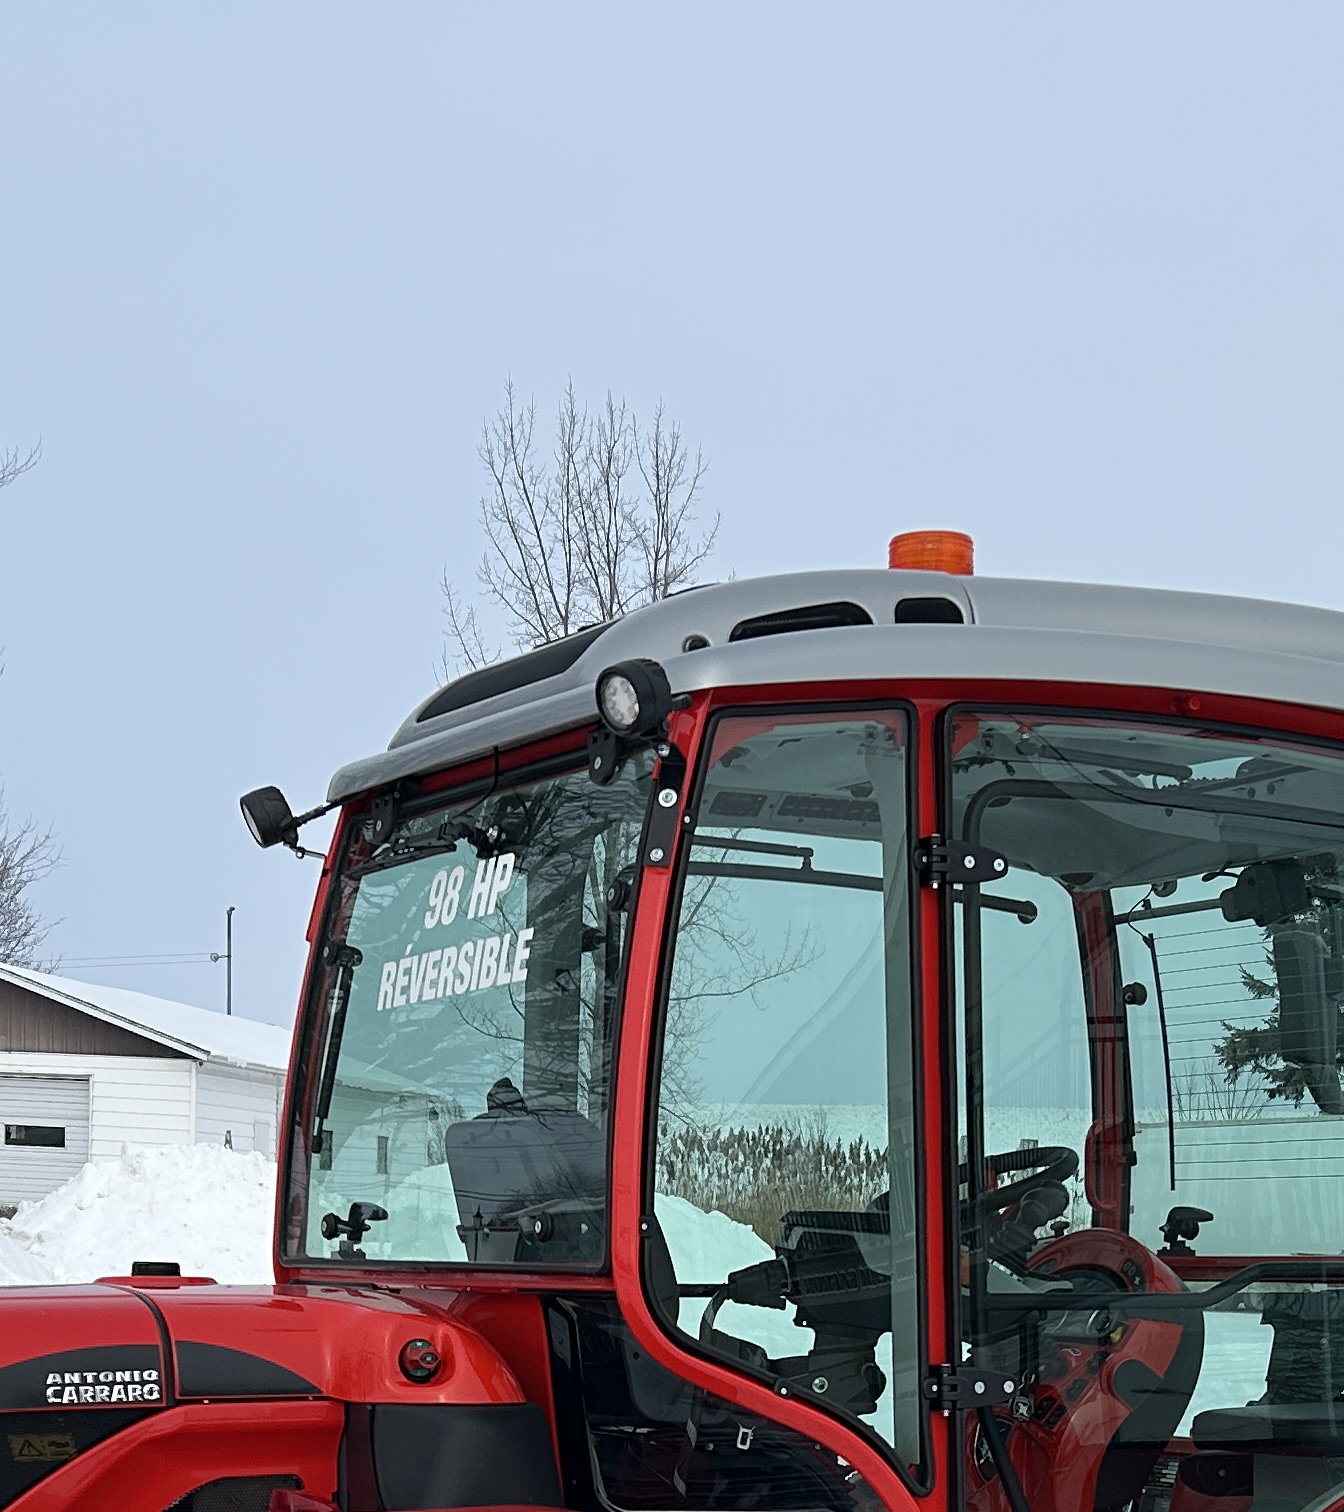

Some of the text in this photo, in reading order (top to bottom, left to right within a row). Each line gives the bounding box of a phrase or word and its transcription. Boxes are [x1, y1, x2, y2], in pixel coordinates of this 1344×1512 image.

[423, 853, 516, 928] 98 HP
[376, 927, 534, 1011] RÉVERSIBLE
[45, 1369, 160, 1385] ANTONIO
[46, 1383, 161, 1404] CARRARO
